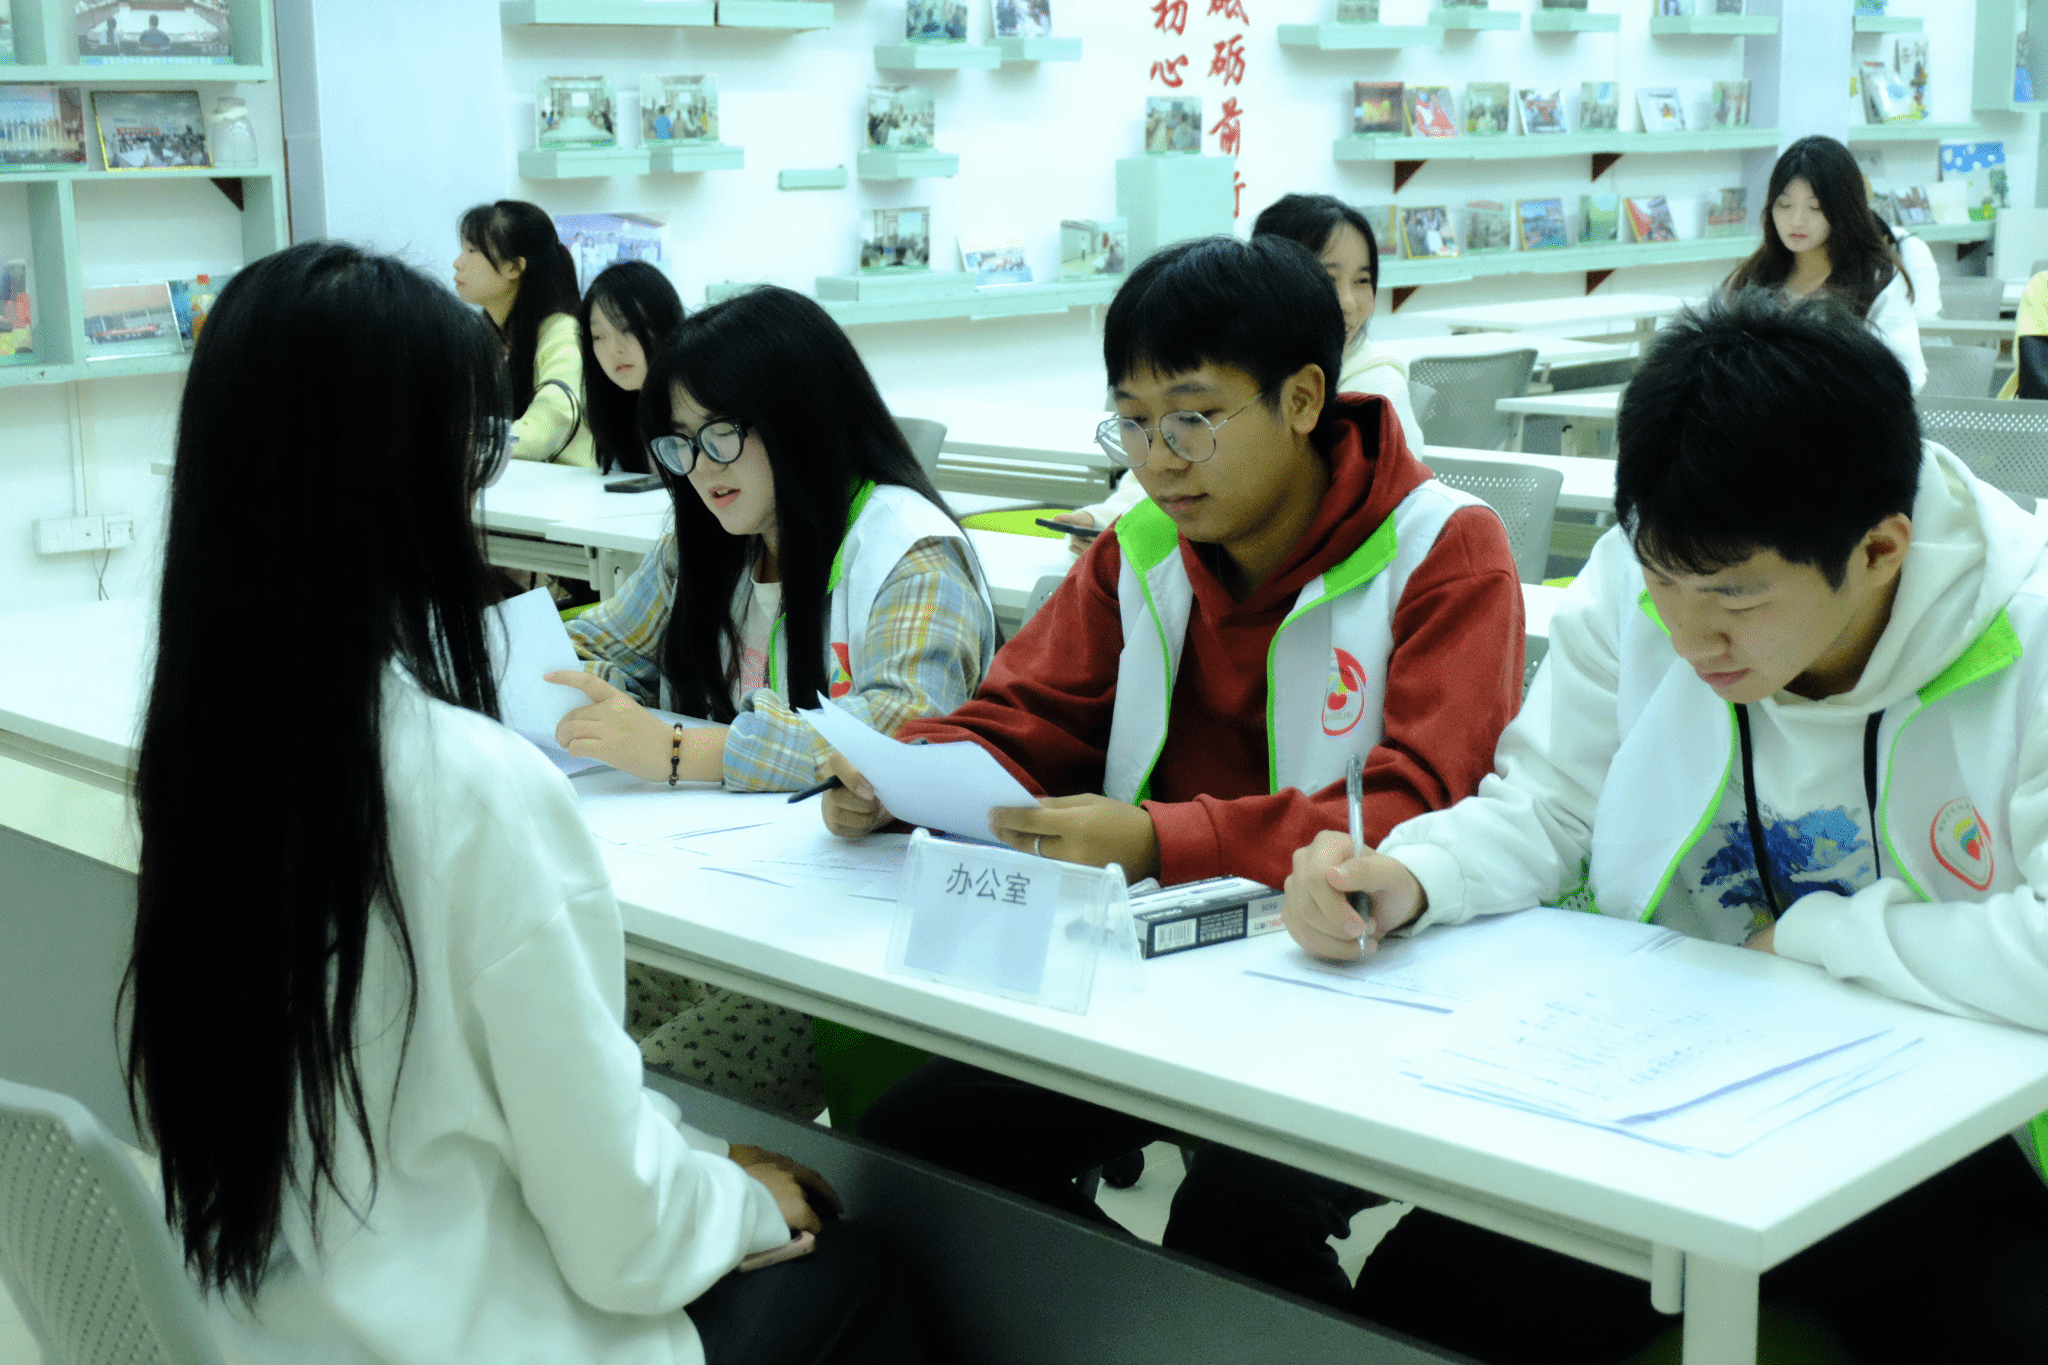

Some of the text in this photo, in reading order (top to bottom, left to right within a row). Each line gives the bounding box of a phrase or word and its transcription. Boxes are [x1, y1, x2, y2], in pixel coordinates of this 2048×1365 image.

[1206, 0, 1249, 219] 砺前
[944, 862, 1031, 906] 办公室
